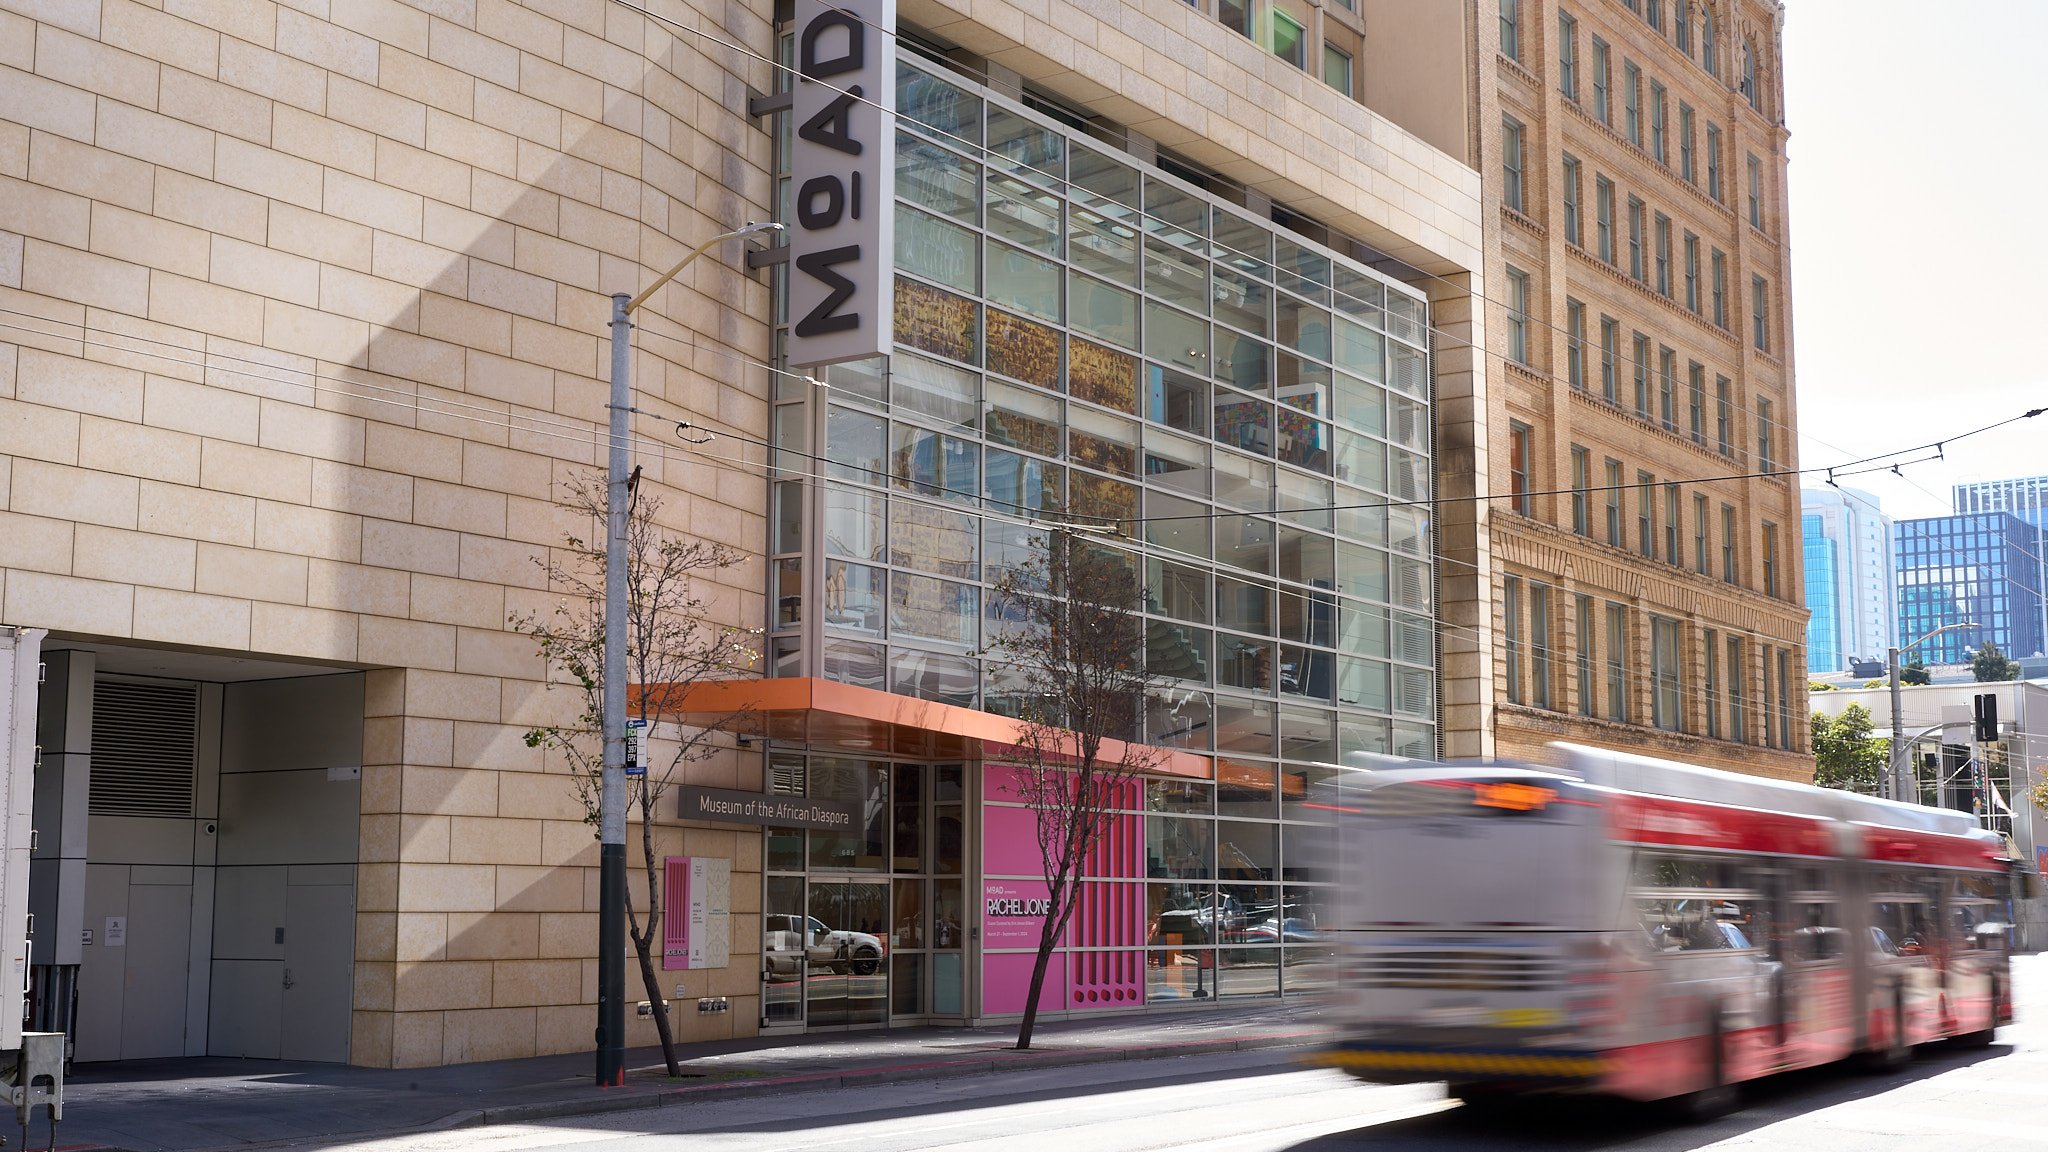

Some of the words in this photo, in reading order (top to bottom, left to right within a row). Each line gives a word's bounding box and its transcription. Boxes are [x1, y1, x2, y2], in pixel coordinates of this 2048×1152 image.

[627, 737, 637, 745] 292
[627, 745, 637, 753] 397
[627, 754, 637, 762] EPX
[700, 795, 742, 814] Museum
[745, 800, 755, 816] of
[758, 803, 774, 818] the
[776, 803, 809, 821] African
[811, 806, 849, 827] Diaspora
[987, 898, 1023, 915] RACHEL
[1024, 898, 1051, 915] JONE
